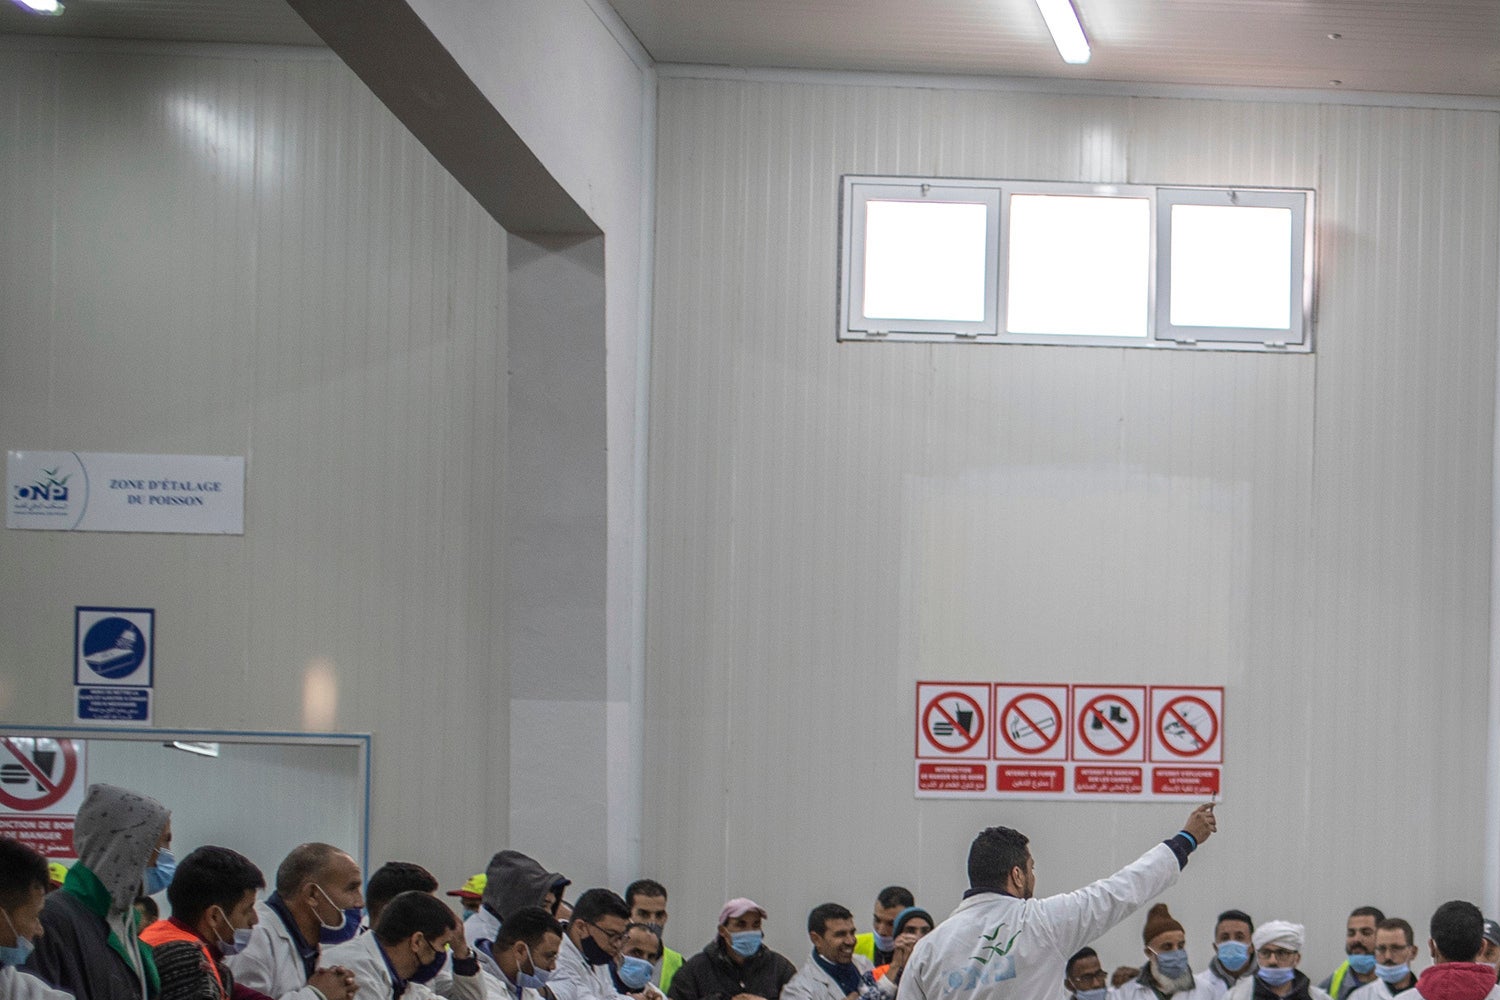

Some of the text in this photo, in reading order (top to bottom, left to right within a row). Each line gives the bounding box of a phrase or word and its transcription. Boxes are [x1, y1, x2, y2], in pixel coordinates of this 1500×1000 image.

[110, 479, 148, 490] ZONE
[127, 494, 204, 506] DU POISSON
